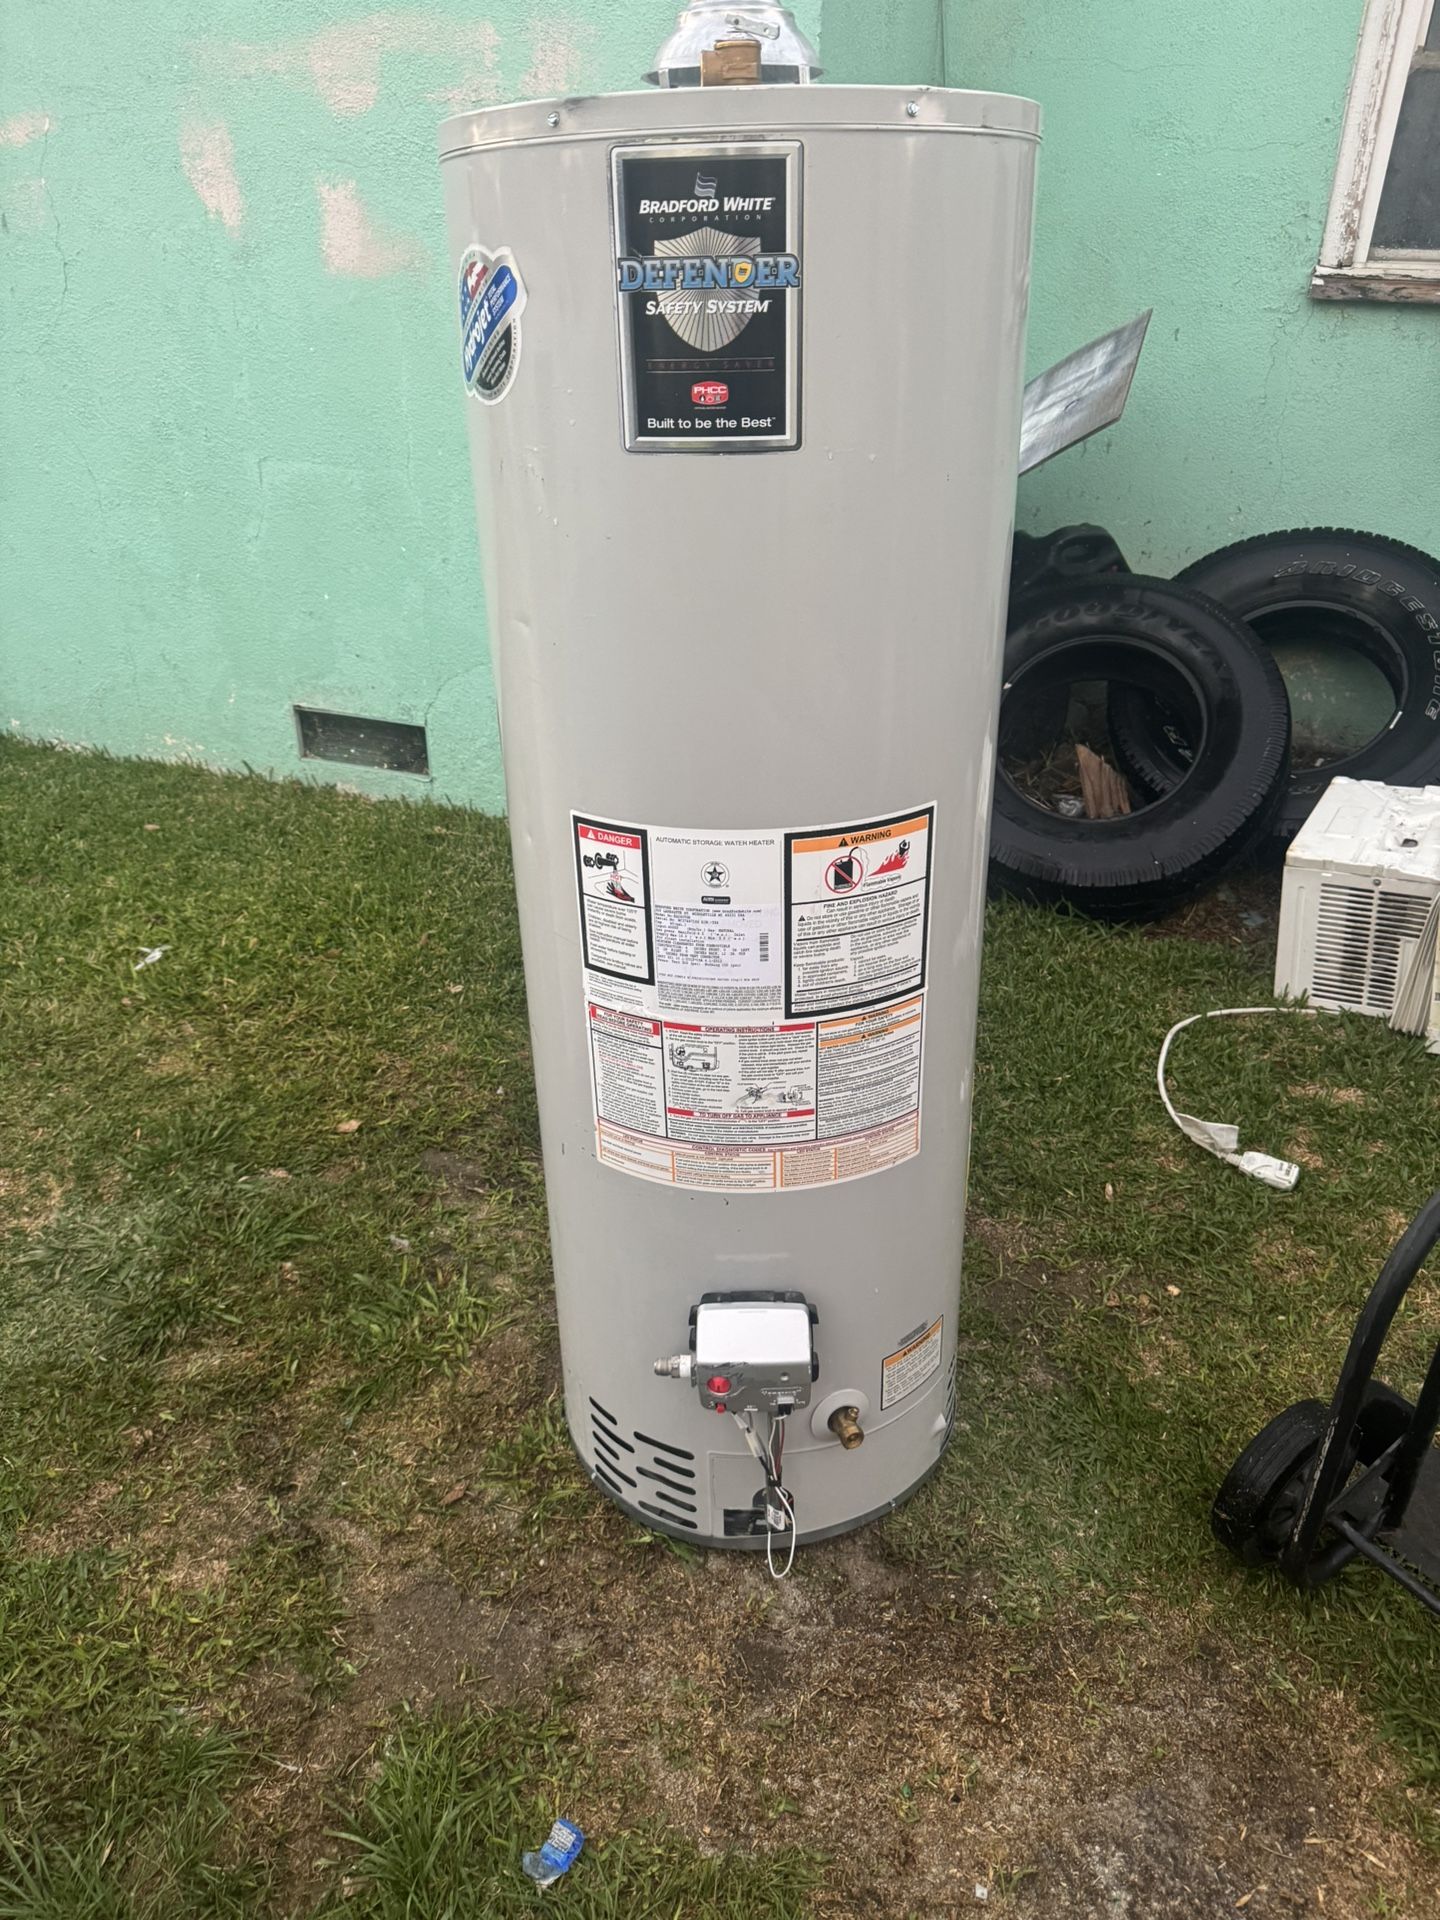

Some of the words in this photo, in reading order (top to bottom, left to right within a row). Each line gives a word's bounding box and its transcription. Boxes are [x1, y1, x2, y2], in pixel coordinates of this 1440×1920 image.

[639, 199, 719, 214] BRADFORD
[724, 197, 773, 212] WHITE
[649, 214, 761, 223] CORPORATION
[619, 254, 799, 292] DEFENDER
[646, 301, 703, 316] SAFETY
[706, 299, 769, 314] SYSTEM
[693, 386, 727, 394] PHCC
[648, 418, 674, 429] Built
[678, 419, 692, 428] to
[695, 418, 712, 429] be
[716, 418, 737, 428] the
[741, 417, 772, 428] Best
[598, 833, 632, 846] DANGER
[656, 836, 691, 845] AUTOMATIC
[850, 830, 891, 844] WARNING
